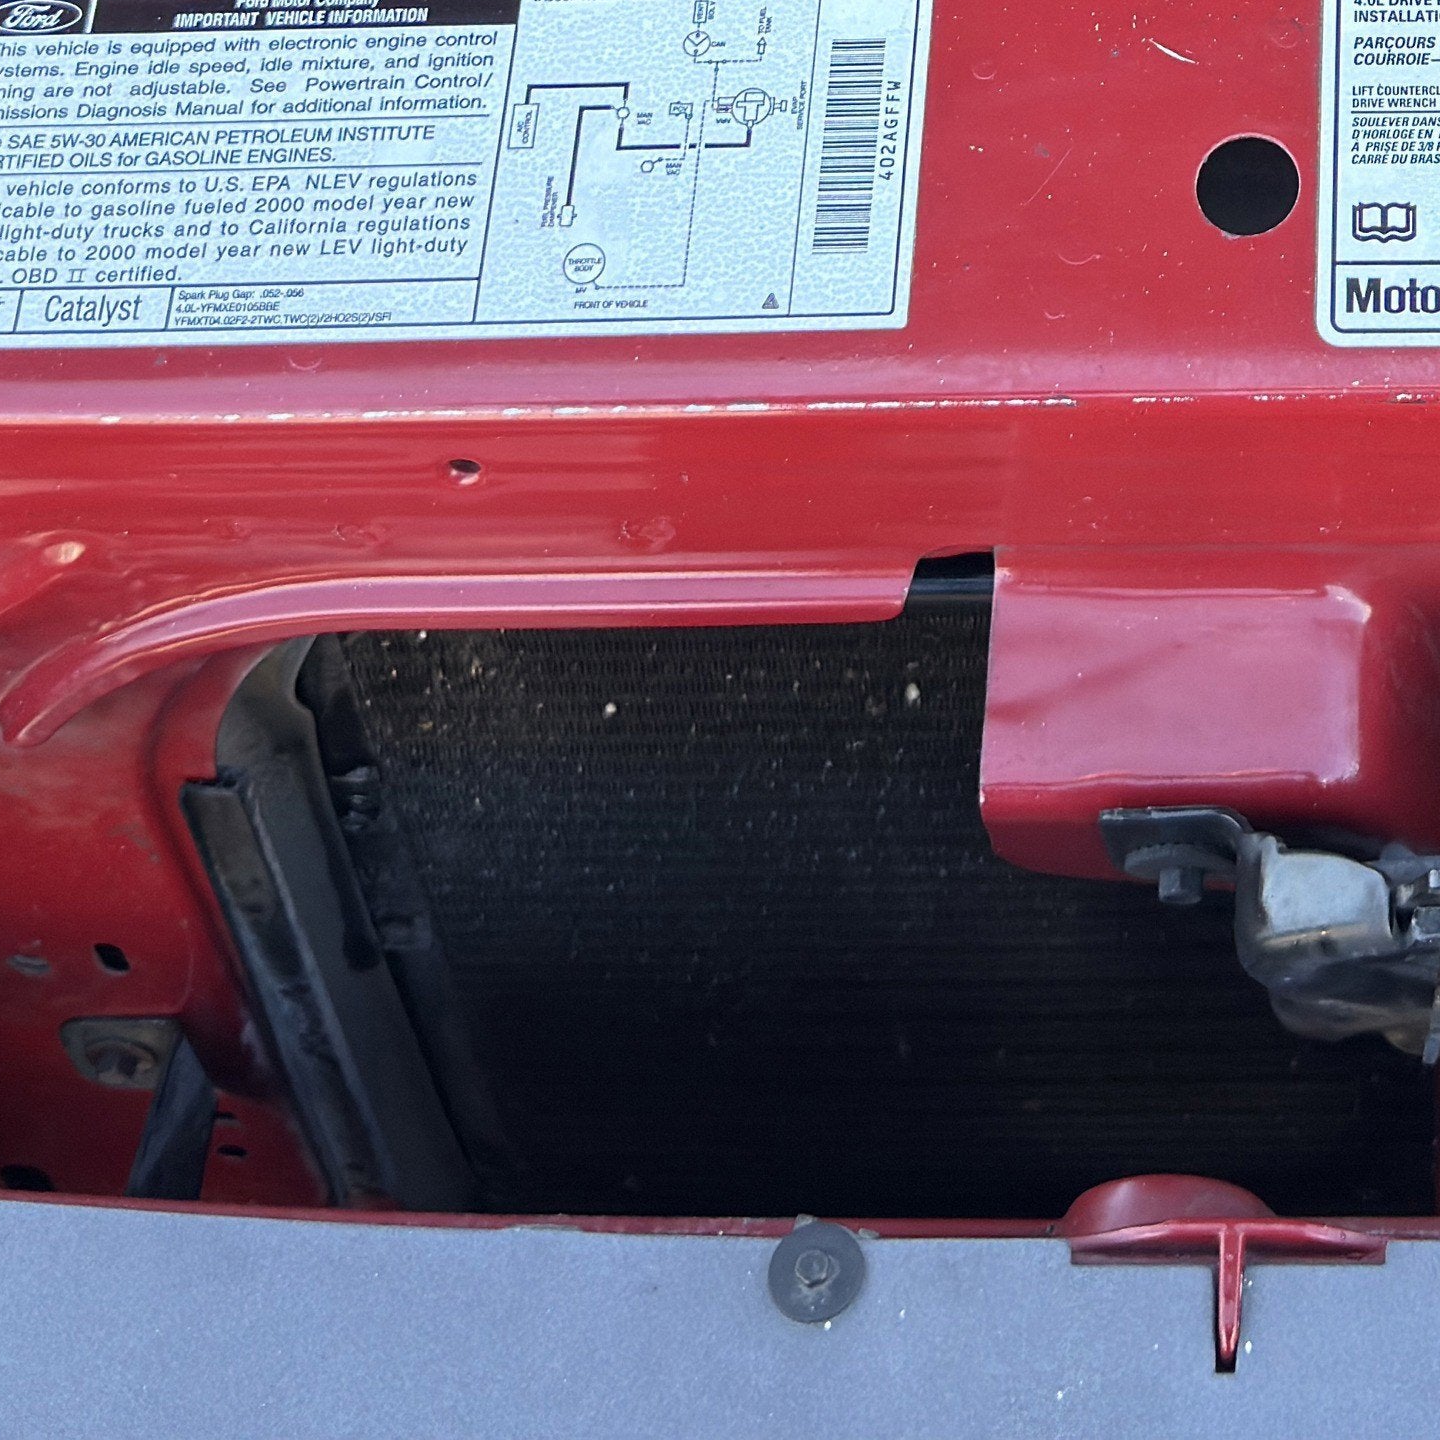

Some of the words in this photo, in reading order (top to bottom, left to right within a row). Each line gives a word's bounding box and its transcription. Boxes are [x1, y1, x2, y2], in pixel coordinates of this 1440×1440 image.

[5, 2, 66, 28] Ford
[173, 11, 259, 27] IMPORTANT
[265, 10, 326, 25] VEHICLE
[327, 7, 428, 24] INFORMATION
[35, 40, 99, 55] vehicle
[107, 40, 122, 54] is
[130, 37, 216, 56] equipped
[224, 37, 260, 51] with
[268, 34, 357, 51] electronic
[365, 32, 426, 51] engine
[434, 30, 497, 46] control
[7, 133, 46, 149] SAE
[50, 133, 106, 148] 5W-30
[108, 130, 210, 147] AMERICAN
[214, 127, 332, 144] PETROLEUM
[337, 125, 435, 141] INSTITUTE
[879, 80, 903, 180] 402AGFFW
[68, 152, 112, 168] OILS
[117, 152, 141, 166] for
[144, 149, 242, 166] GASOLINE
[246, 147, 336, 163] ENGINES.
[44, 295, 143, 324] Catalyst
